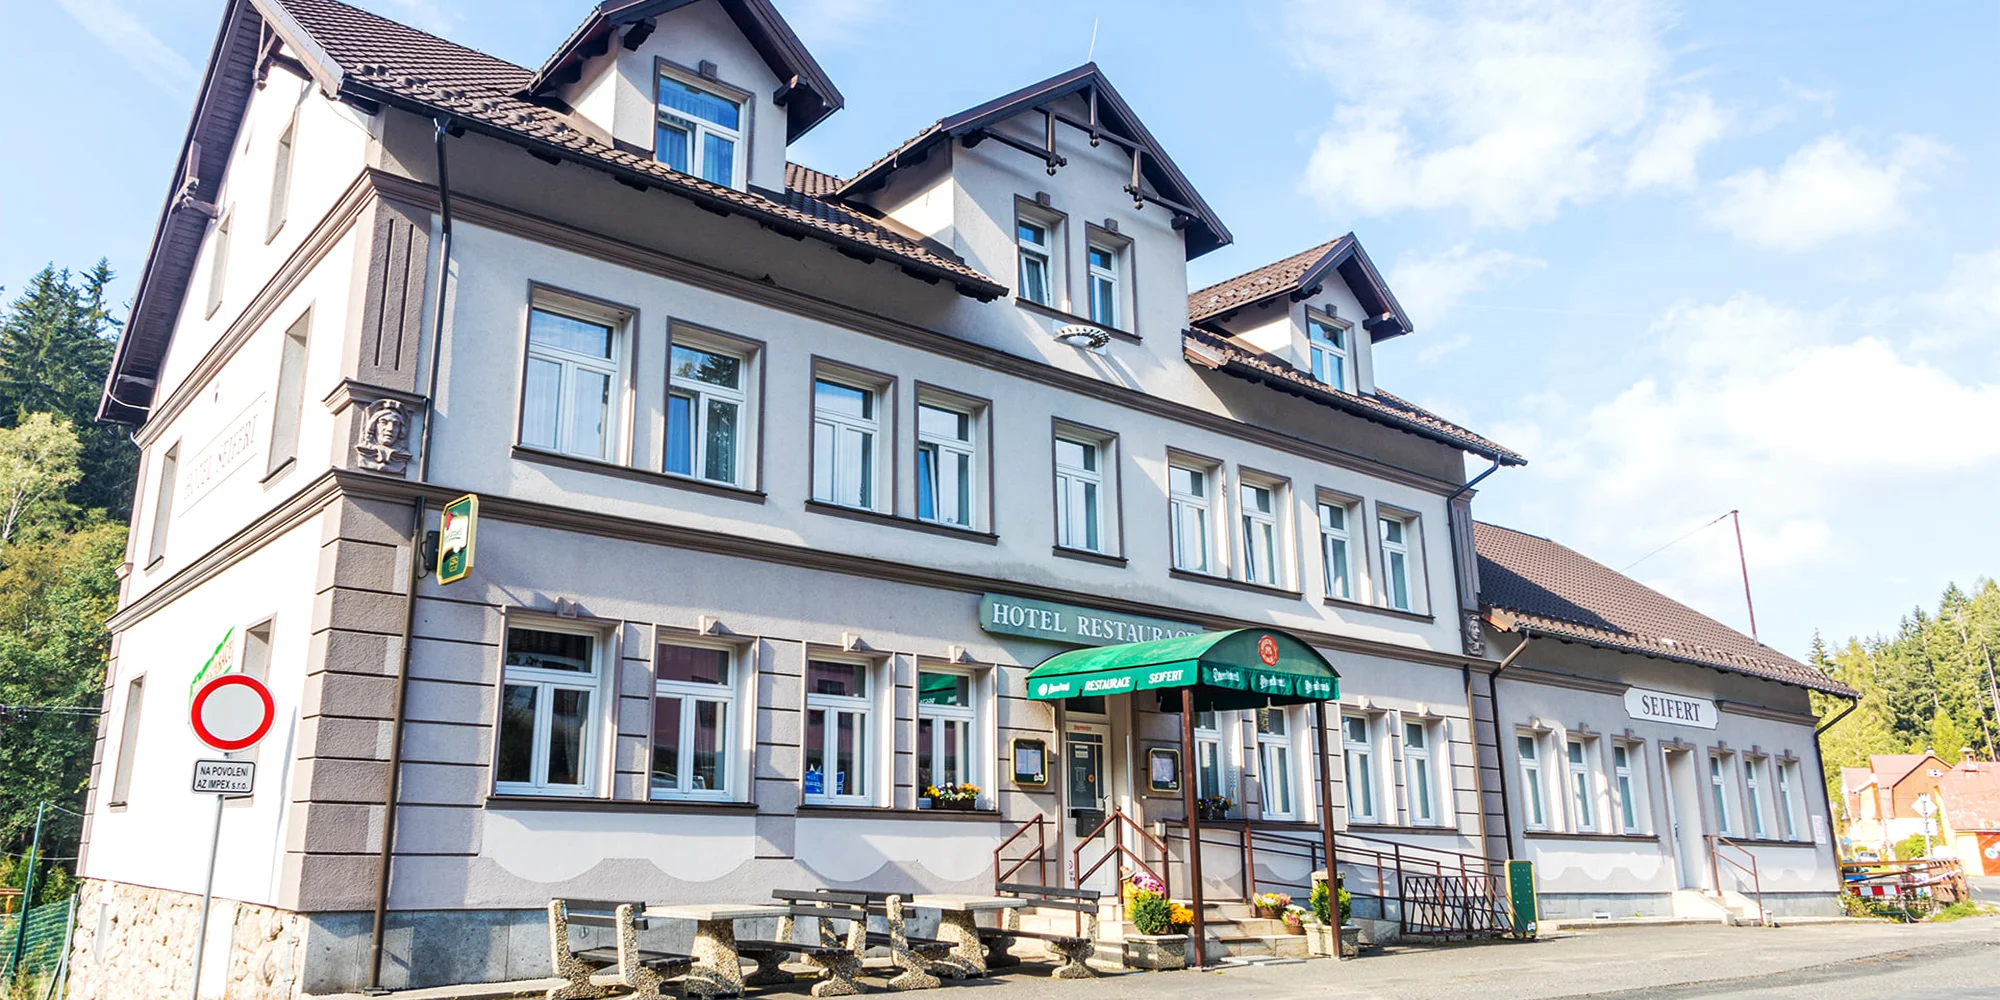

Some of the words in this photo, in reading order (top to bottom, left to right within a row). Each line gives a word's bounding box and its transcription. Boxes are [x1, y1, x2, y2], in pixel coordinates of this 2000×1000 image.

[992, 603, 1067, 632] HOTEL
[1084, 676, 1131, 691] RESTAURACE
[1148, 669, 1184, 685] SEIFERT
[1641, 694, 1701, 722] SEIFERT
[200, 766, 211, 776] NA
[212, 766, 249, 777] POVOLENÍ
[196, 779, 207, 789] AZ
[208, 780, 231, 789] IMPEX
[231, 782, 248, 790] s.r.o.
